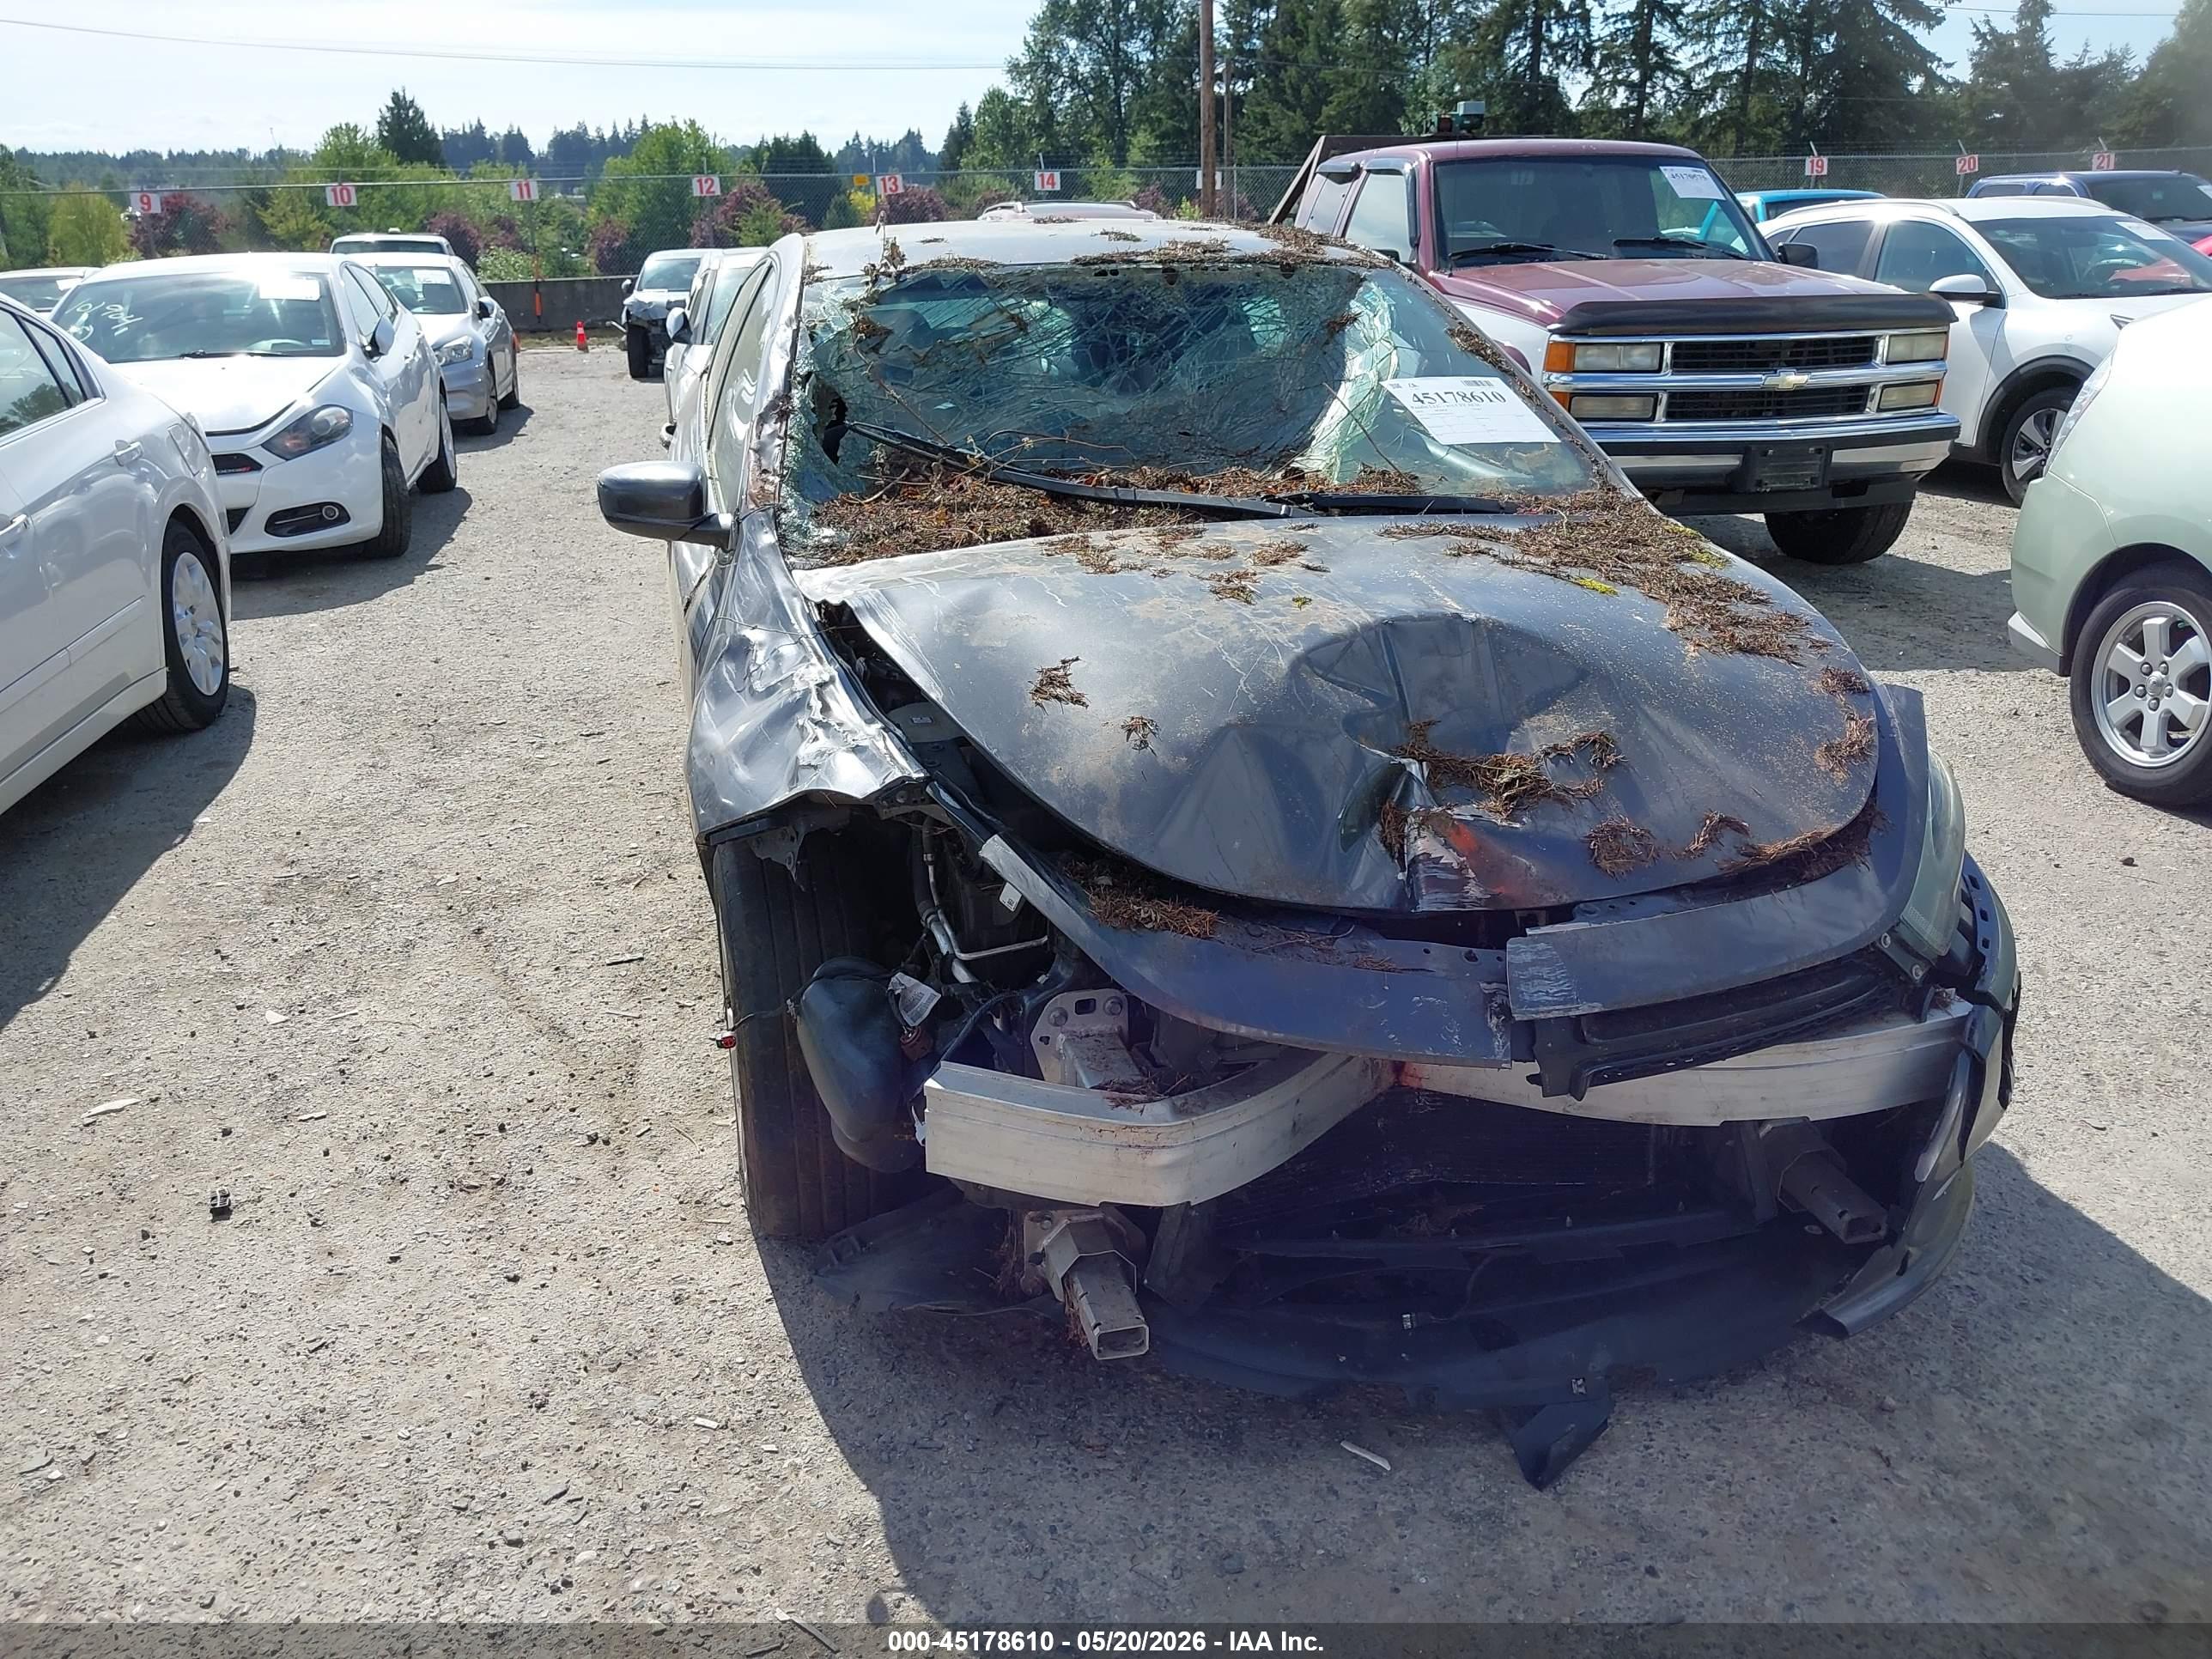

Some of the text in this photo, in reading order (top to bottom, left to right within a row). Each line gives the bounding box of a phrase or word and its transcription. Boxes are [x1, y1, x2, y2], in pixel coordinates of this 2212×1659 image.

[1809, 159, 1825, 174] 19
[1959, 156, 1977, 173] 20
[2096, 155, 2111, 170] 21
[696, 178, 715, 195] 12
[881, 176, 899, 193] 13
[1039, 173, 1056, 189] 14
[331, 186, 352, 205] 10
[516, 182, 532, 199] 11
[140, 193, 152, 212] 9
[1412, 391, 1506, 404] 45178610
